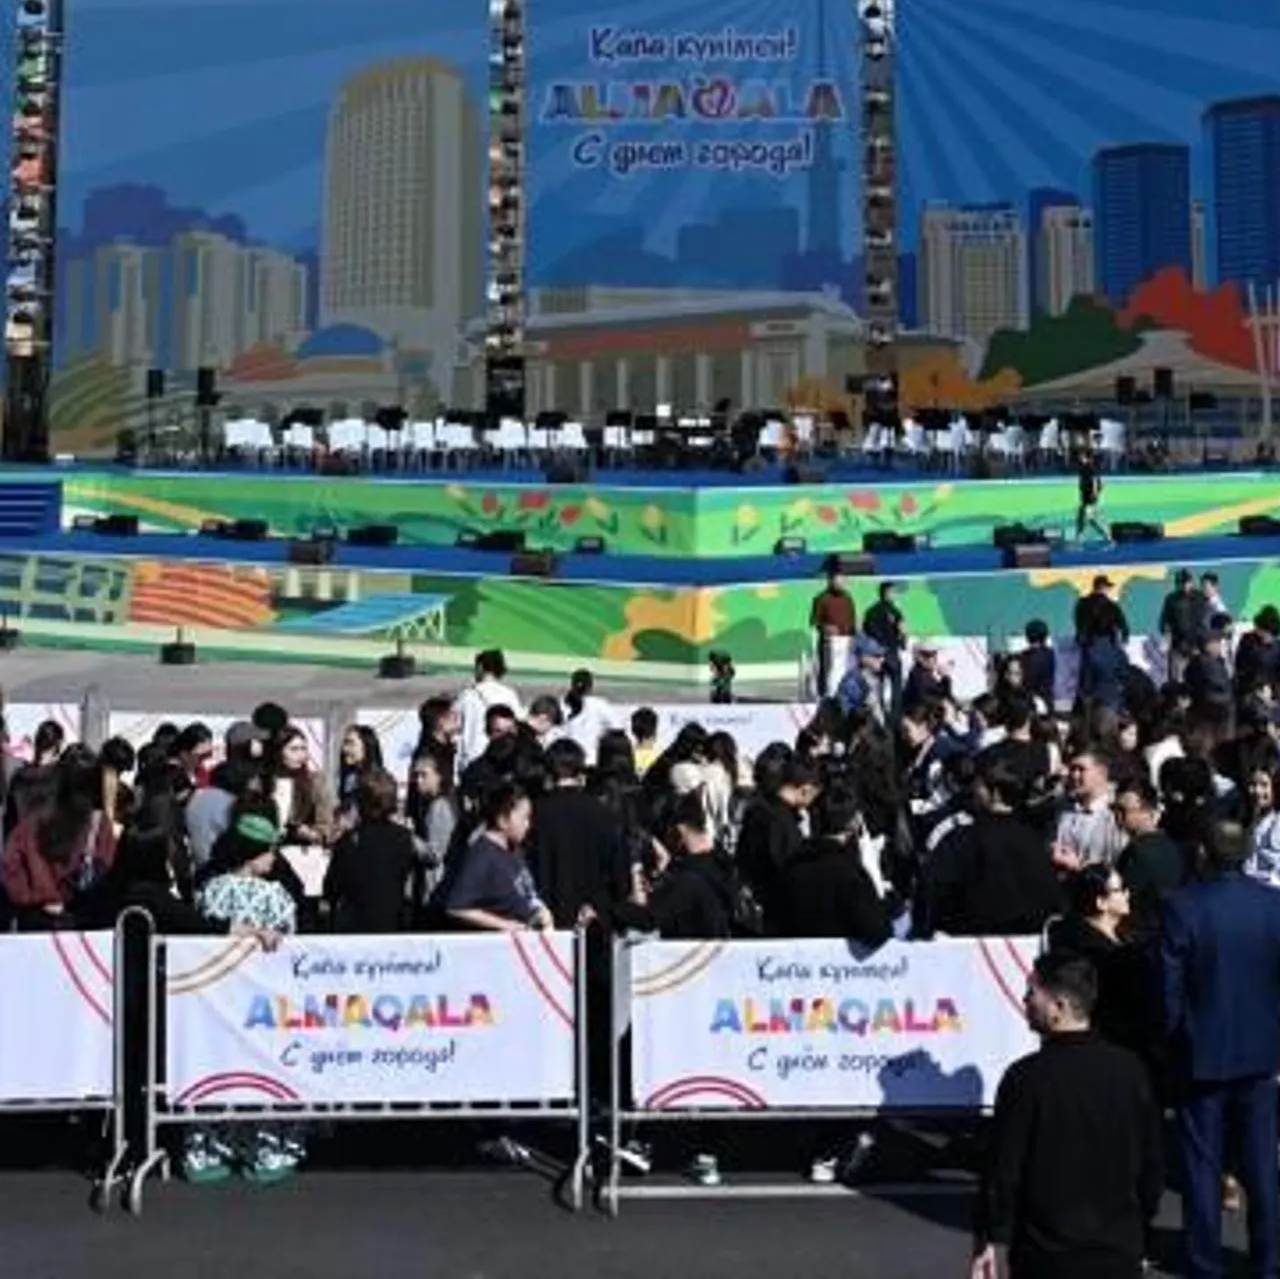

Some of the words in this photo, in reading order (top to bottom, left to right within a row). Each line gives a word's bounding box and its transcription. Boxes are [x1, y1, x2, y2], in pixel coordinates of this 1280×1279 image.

[573, 133, 602, 165] С
[243, 994, 495, 1032] ALMAQALA
[709, 997, 964, 1037] ALMAQALA
[280, 1040, 302, 1066] С
[747, 1047, 768, 1071] С
